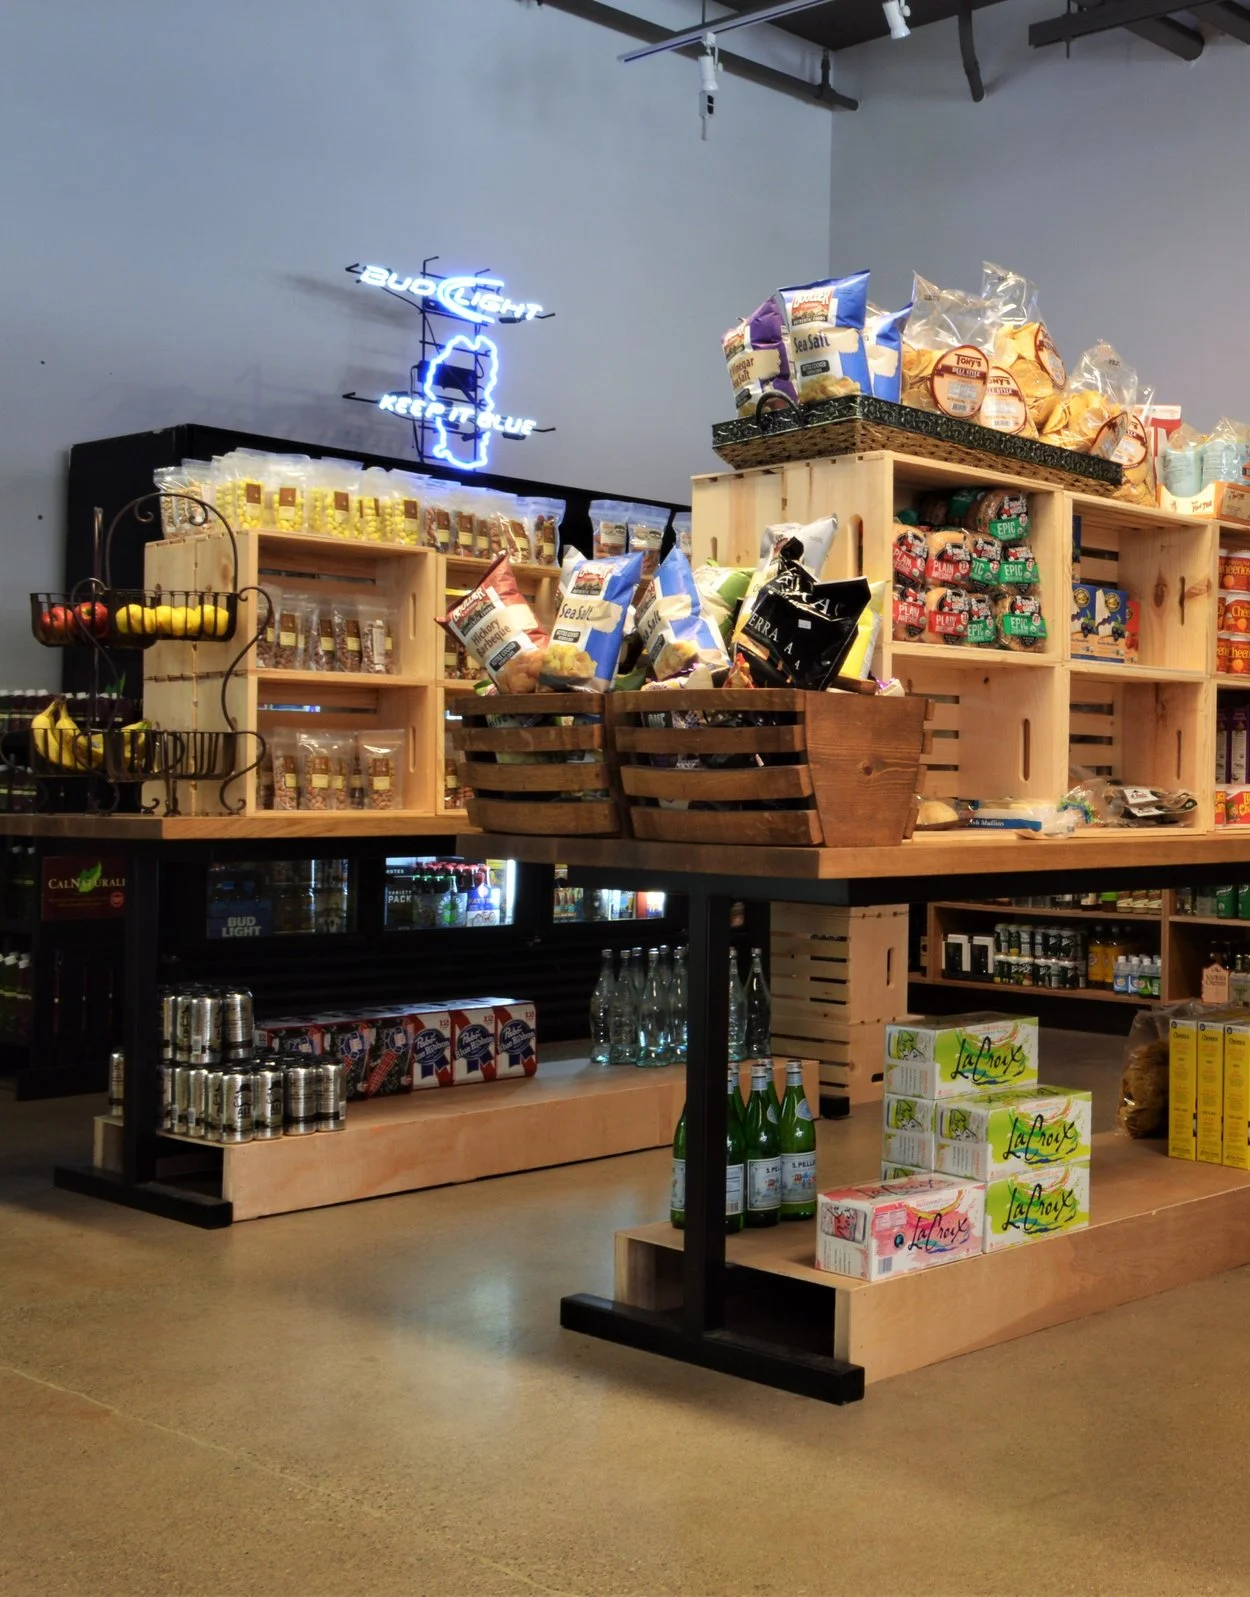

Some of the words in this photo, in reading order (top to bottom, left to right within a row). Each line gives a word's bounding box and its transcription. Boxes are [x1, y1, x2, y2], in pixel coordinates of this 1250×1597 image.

[360, 265, 436, 296] BUD
[454, 288, 543, 320] LIGHT
[793, 338, 809, 354] Sea
[809, 333, 831, 351] Salt
[955, 354, 982, 369] TONY'S
[988, 375, 1011, 387] ONY'S
[379, 394, 446, 418] KEEP
[448, 407, 475, 424] IT
[477, 411, 537, 435] BLUE
[997, 523, 1016, 535] EPIC
[933, 560, 954, 575] PLAIN
[972, 562, 985, 575] PIC
[1004, 565, 1023, 576] EPIC
[559, 603, 577, 619] Sea
[576, 605, 593, 622] Salt
[470, 617, 501, 646] Hickory
[748, 614, 779, 642] ERRA
[968, 625, 984, 636] EPIC
[1010, 618, 1029, 630] EPIC
[475, 624, 512, 659] Barbeque
[388, 895, 412, 904] PACK
[227, 916, 257, 928] BUD
[222, 926, 262, 938] LIGHT
[950, 1036, 1023, 1080] LaCroix
[1002, 1114, 1075, 1160] LaCroix
[1001, 1183, 1074, 1231] LaCroix
[907, 1213, 968, 1251] LaCroix
